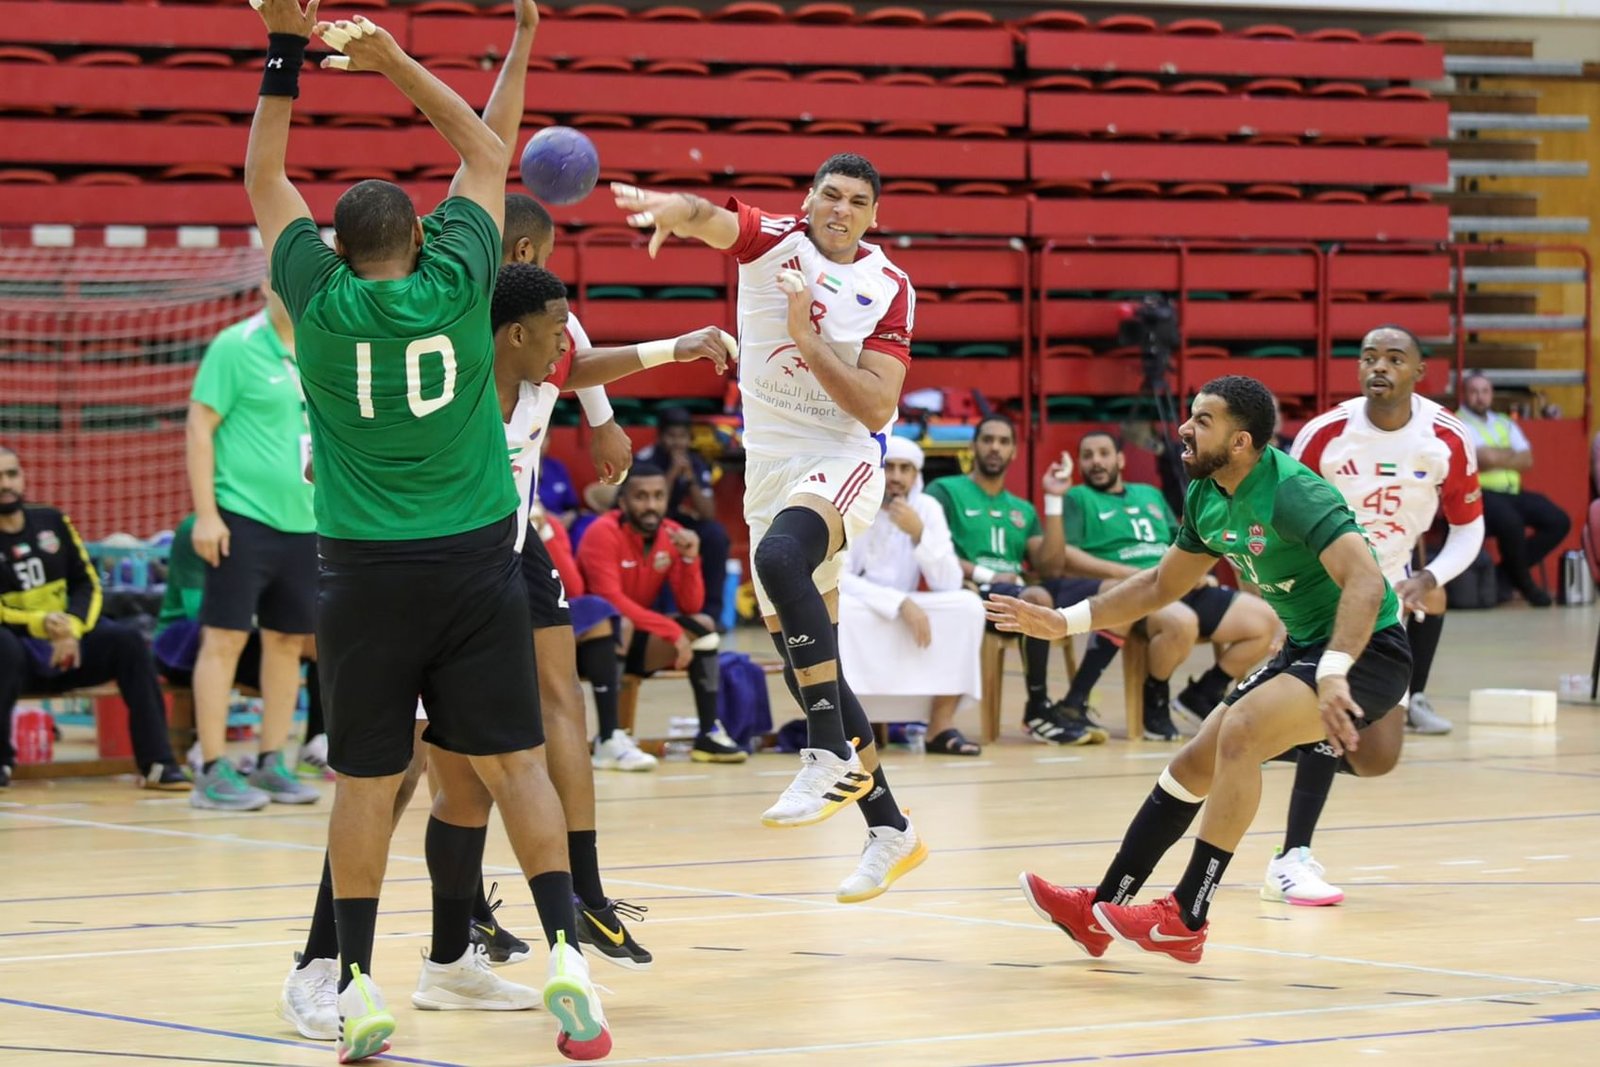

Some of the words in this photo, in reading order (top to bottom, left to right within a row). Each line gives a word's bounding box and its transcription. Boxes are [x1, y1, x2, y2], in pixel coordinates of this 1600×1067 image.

[356, 334, 458, 419] 10
[754, 376, 802, 398] الشارقة
[754, 388, 792, 409] Sharjah
[794, 402, 837, 417] Airport
[804, 389, 835, 403] طار
[1363, 485, 1402, 517] 45
[990, 526, 1006, 555] 11
[1130, 518, 1157, 543] 13
[13, 557, 46, 591] 50
